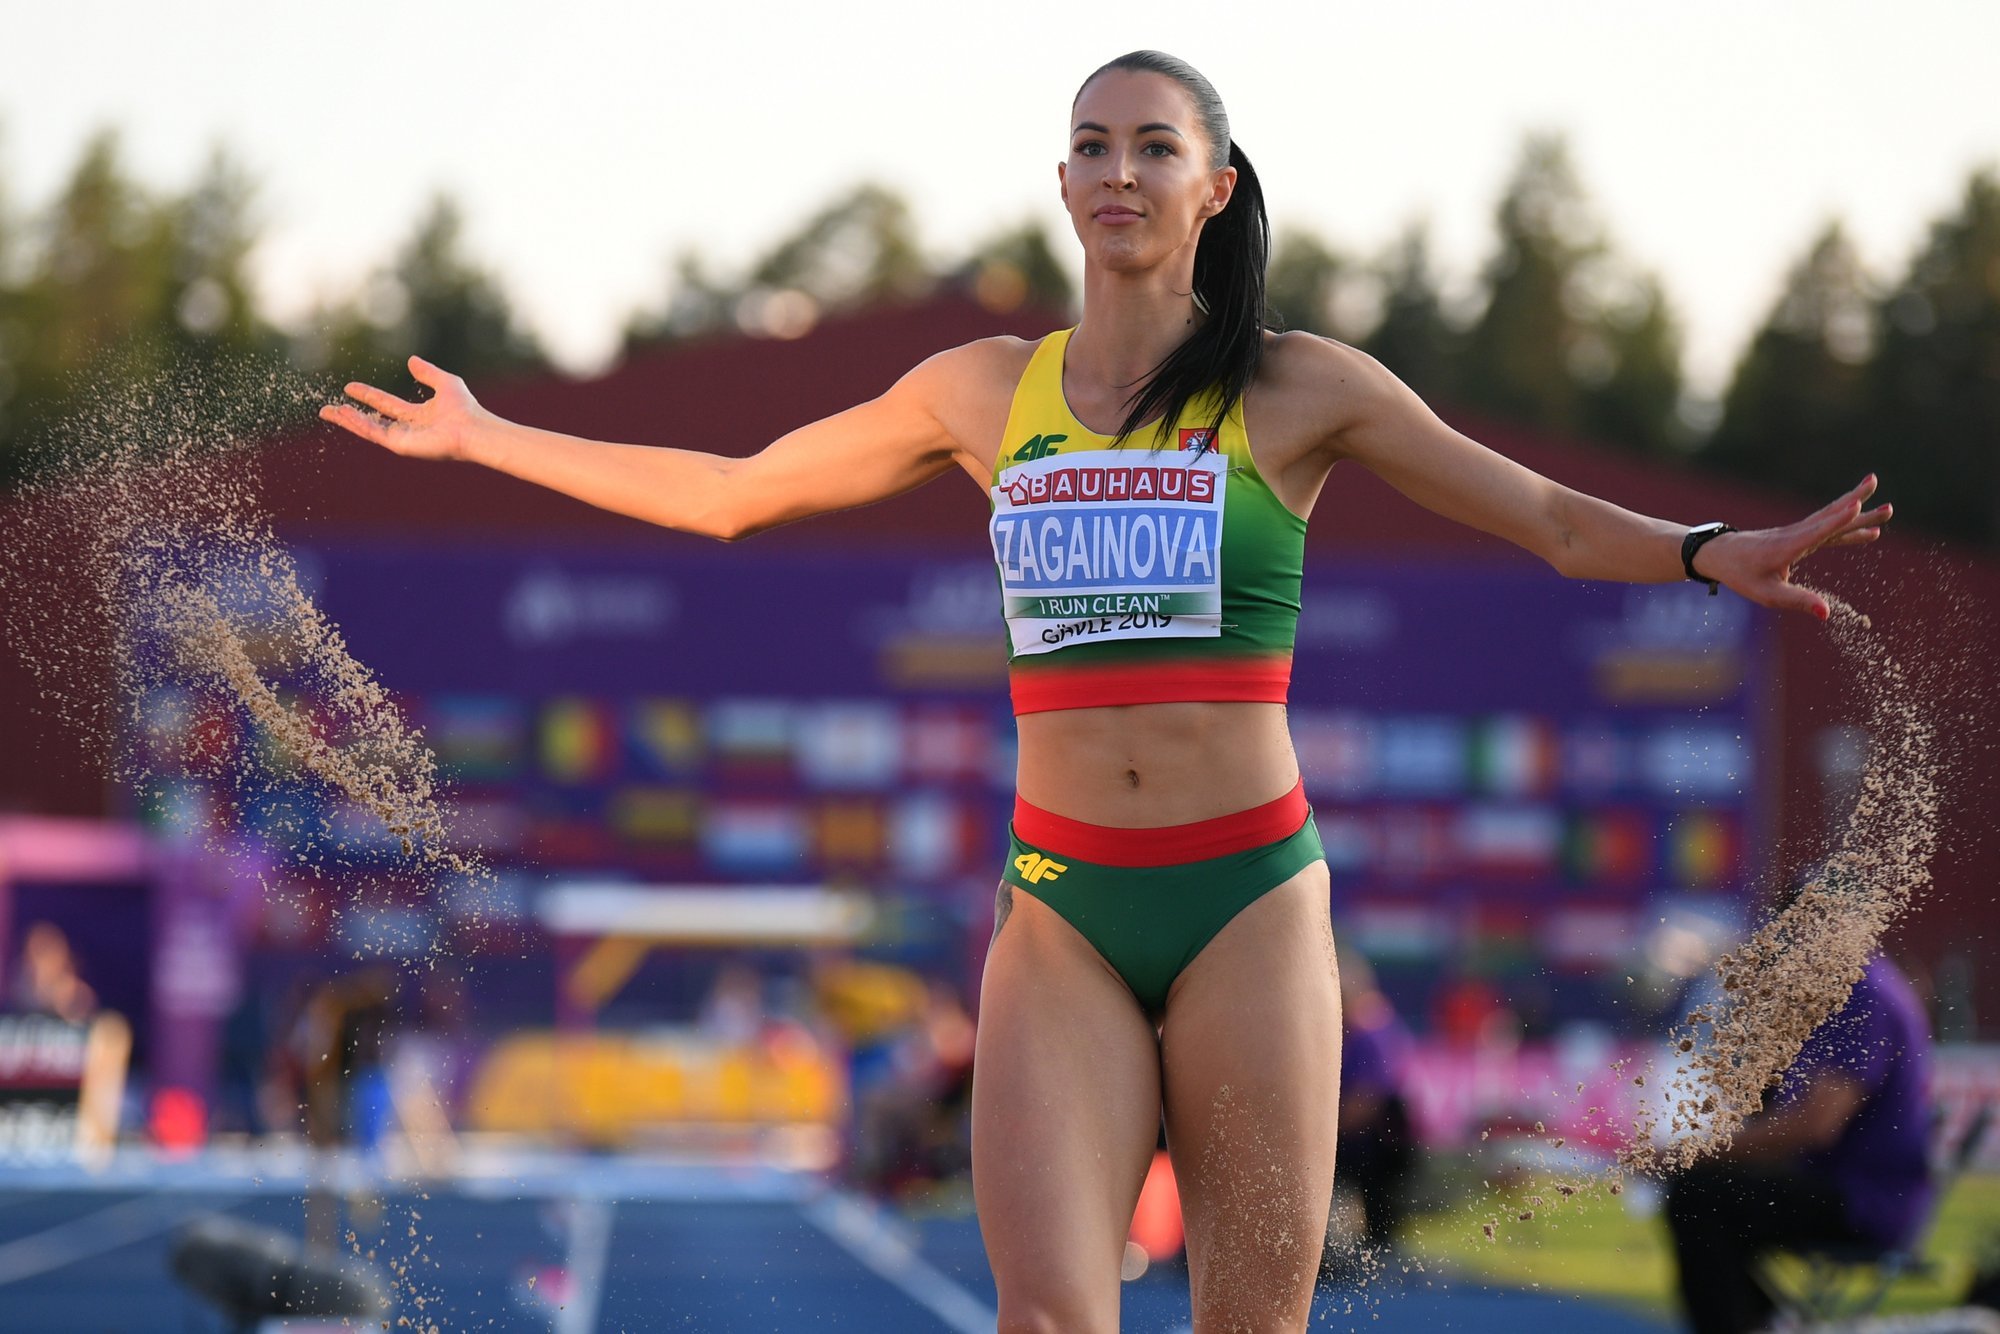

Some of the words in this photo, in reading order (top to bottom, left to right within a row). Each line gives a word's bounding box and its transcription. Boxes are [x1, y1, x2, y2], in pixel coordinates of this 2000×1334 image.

[1030, 471, 1210, 498] BAUHAUS
[996, 514, 1213, 582] ZAGAINOVA
[1039, 600, 1046, 615] I
[1050, 598, 1087, 615] RUN
[1014, 853, 1068, 884] 4F
